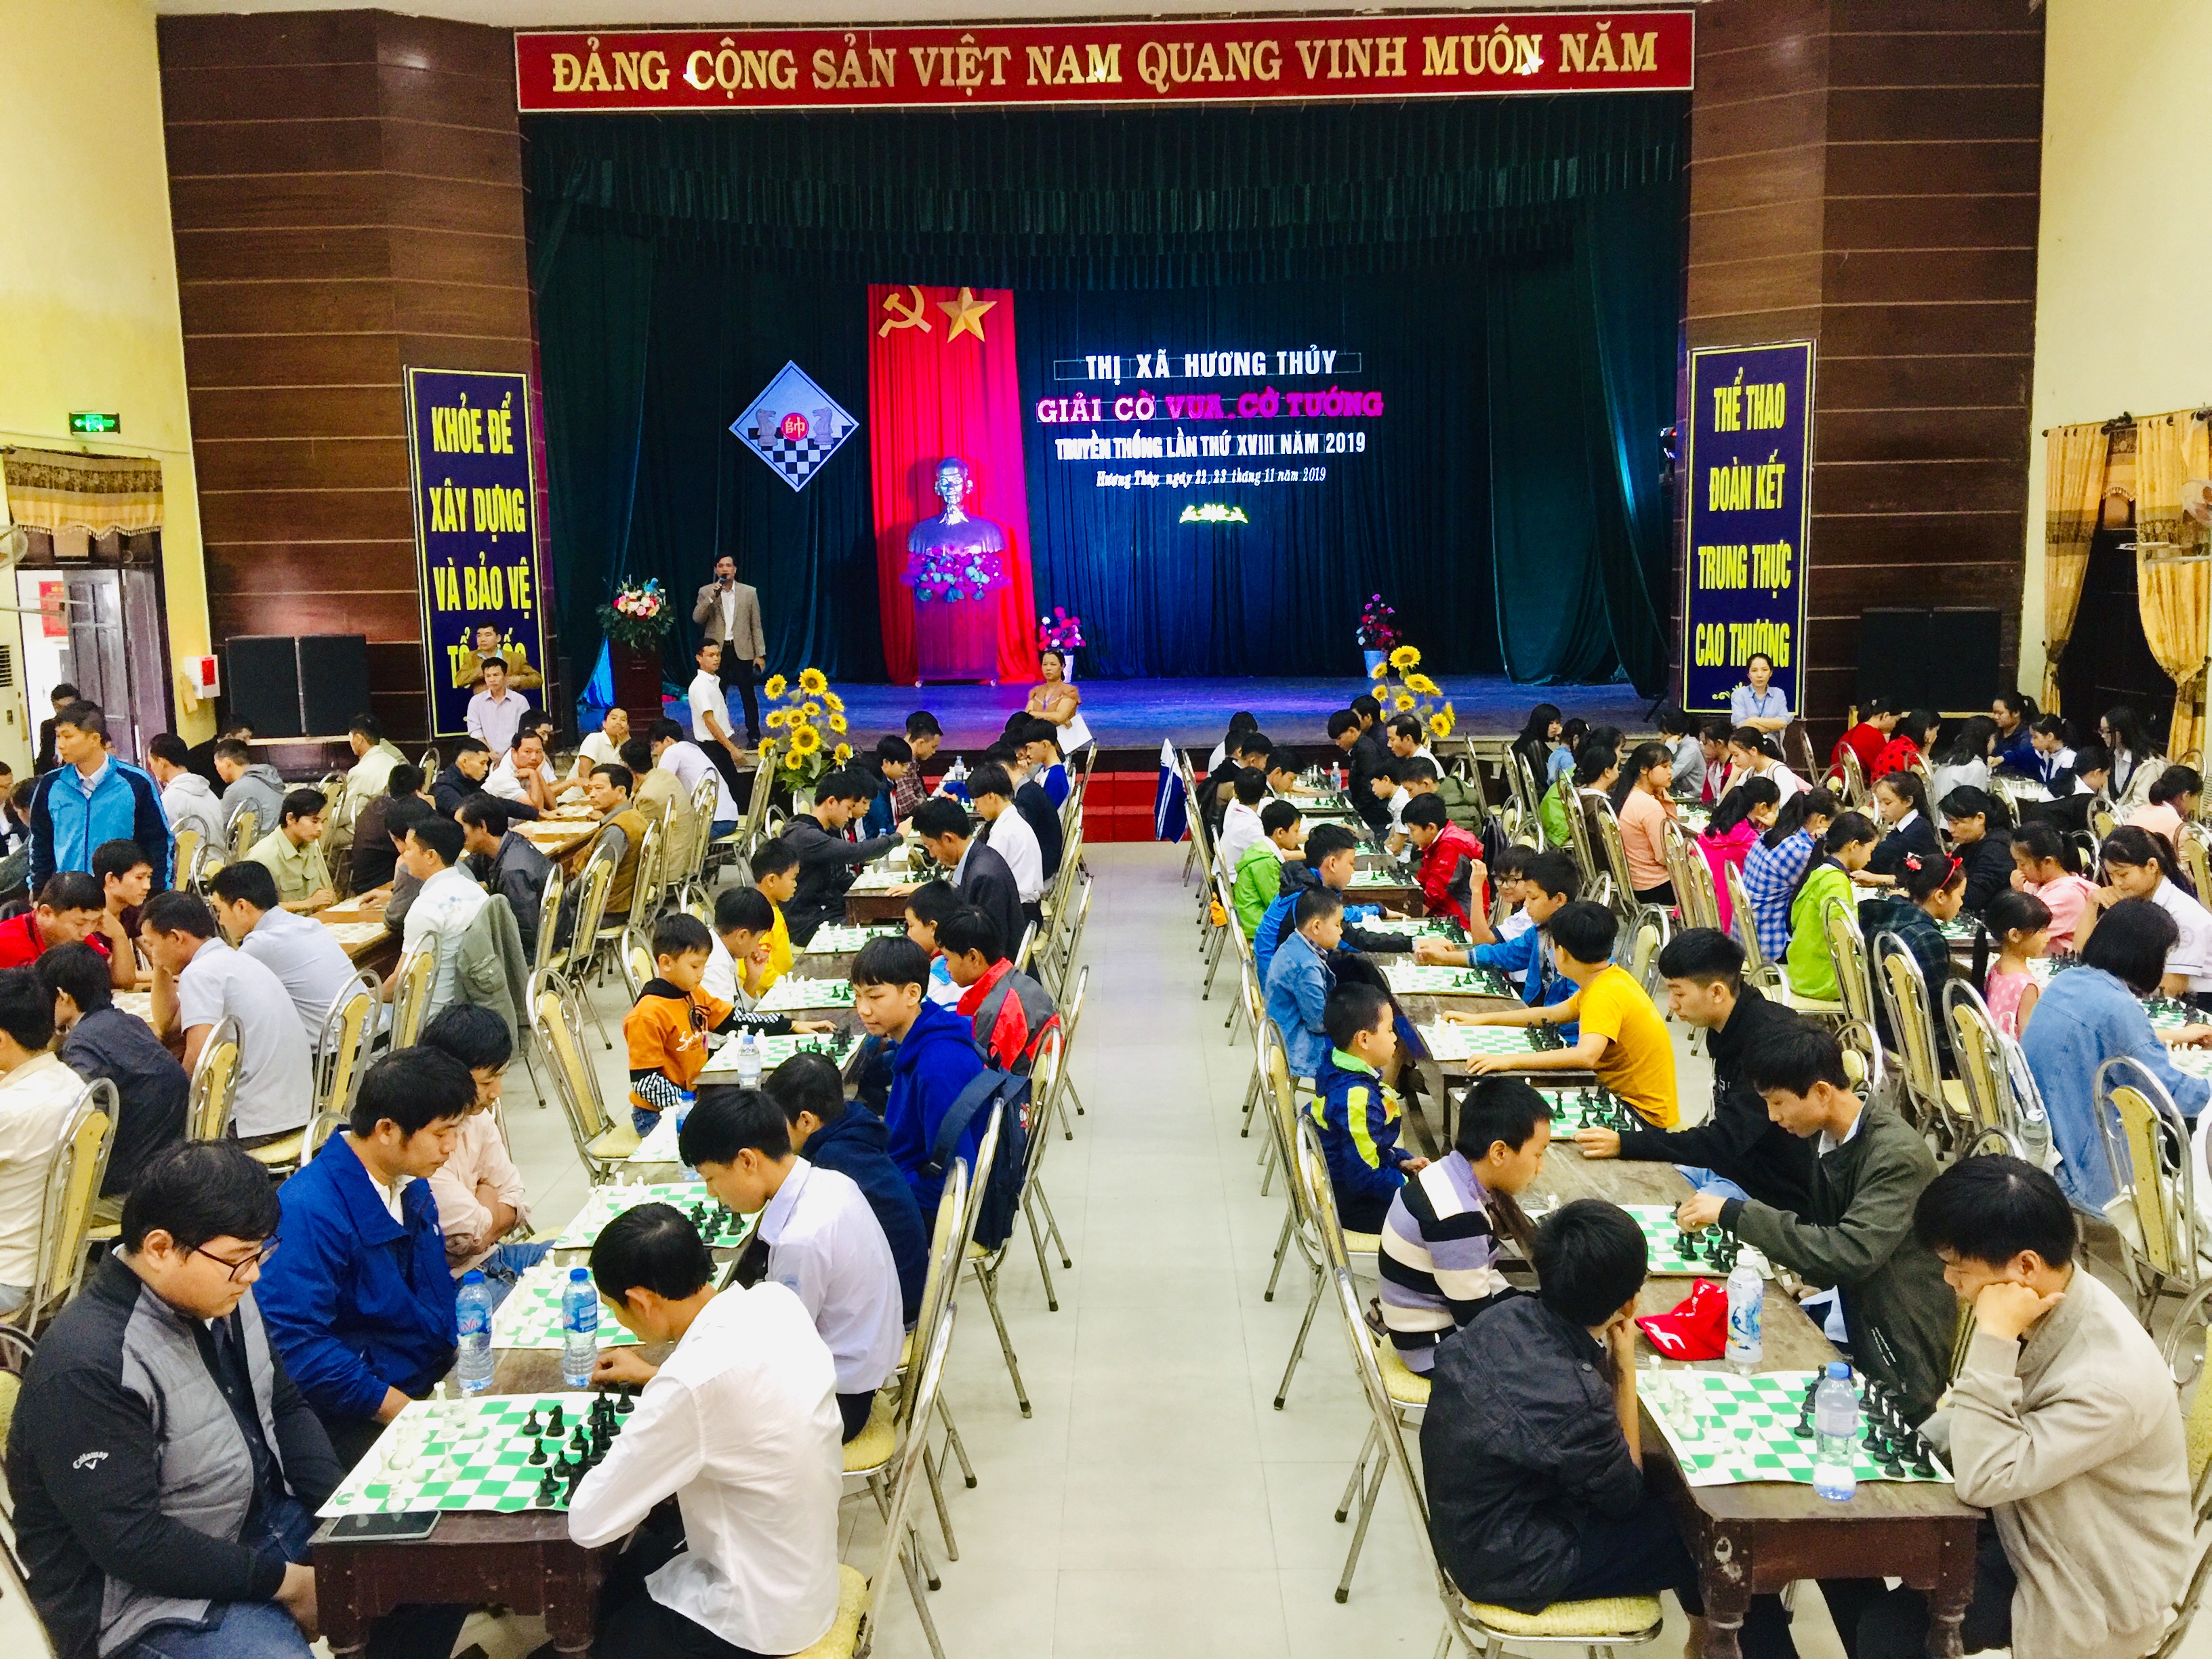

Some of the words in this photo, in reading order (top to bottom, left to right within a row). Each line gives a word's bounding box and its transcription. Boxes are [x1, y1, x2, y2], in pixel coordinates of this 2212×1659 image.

[552, 36, 669, 92] ĐẢNG
[685, 37, 798, 99] CỘNG
[812, 33, 897, 89] SẢN
[909, 33, 1012, 96] VIỆT
[1026, 43, 1122, 85] NAM
[1137, 39, 1282, 93] QUANG
[1295, 37, 1407, 79] VINH
[1422, 22, 1544, 77] MUÔN
[1559, 20, 1658, 73] NĂM
[1086, 354, 1121, 386] THỊ
[1136, 349, 1170, 379] XÃ
[1185, 351, 1267, 377] HƯƠNG
[1277, 344, 1337, 375] THỦY
[431, 392, 484, 454] KHỎE
[487, 391, 514, 454] ĐỂ
[1038, 392, 1101, 423] GIẢI
[1114, 390, 1155, 421] CỜ
[1286, 385, 1385, 417] TƯỚNG
[1714, 367, 1744, 432] THỂ
[1746, 382, 1786, 429] THAO
[1166, 426, 1197, 457] LẦN
[1200, 430, 1232, 456] THỨ
[1237, 434, 1274, 455] XVIII
[1280, 430, 1319, 455] NĂM
[1326, 432, 1366, 453] 2019
[1264, 468, 1275, 483] 11
[1277, 469, 1299, 483] năm
[1303, 467, 1326, 483] 2019
[1709, 456, 1752, 512] ĐOÀN
[1755, 449, 1786, 510] KẾT
[429, 477, 466, 533] XÂY
[472, 483, 526, 542] DỰNG
[433, 556, 459, 611] VÀ
[466, 551, 501, 611] BẢO
[507, 562, 531, 619] VỆ
[1698, 545, 1747, 590] TRUNG
[1752, 539, 1792, 598] THỰC
[1696, 623, 1725, 667] CAO
